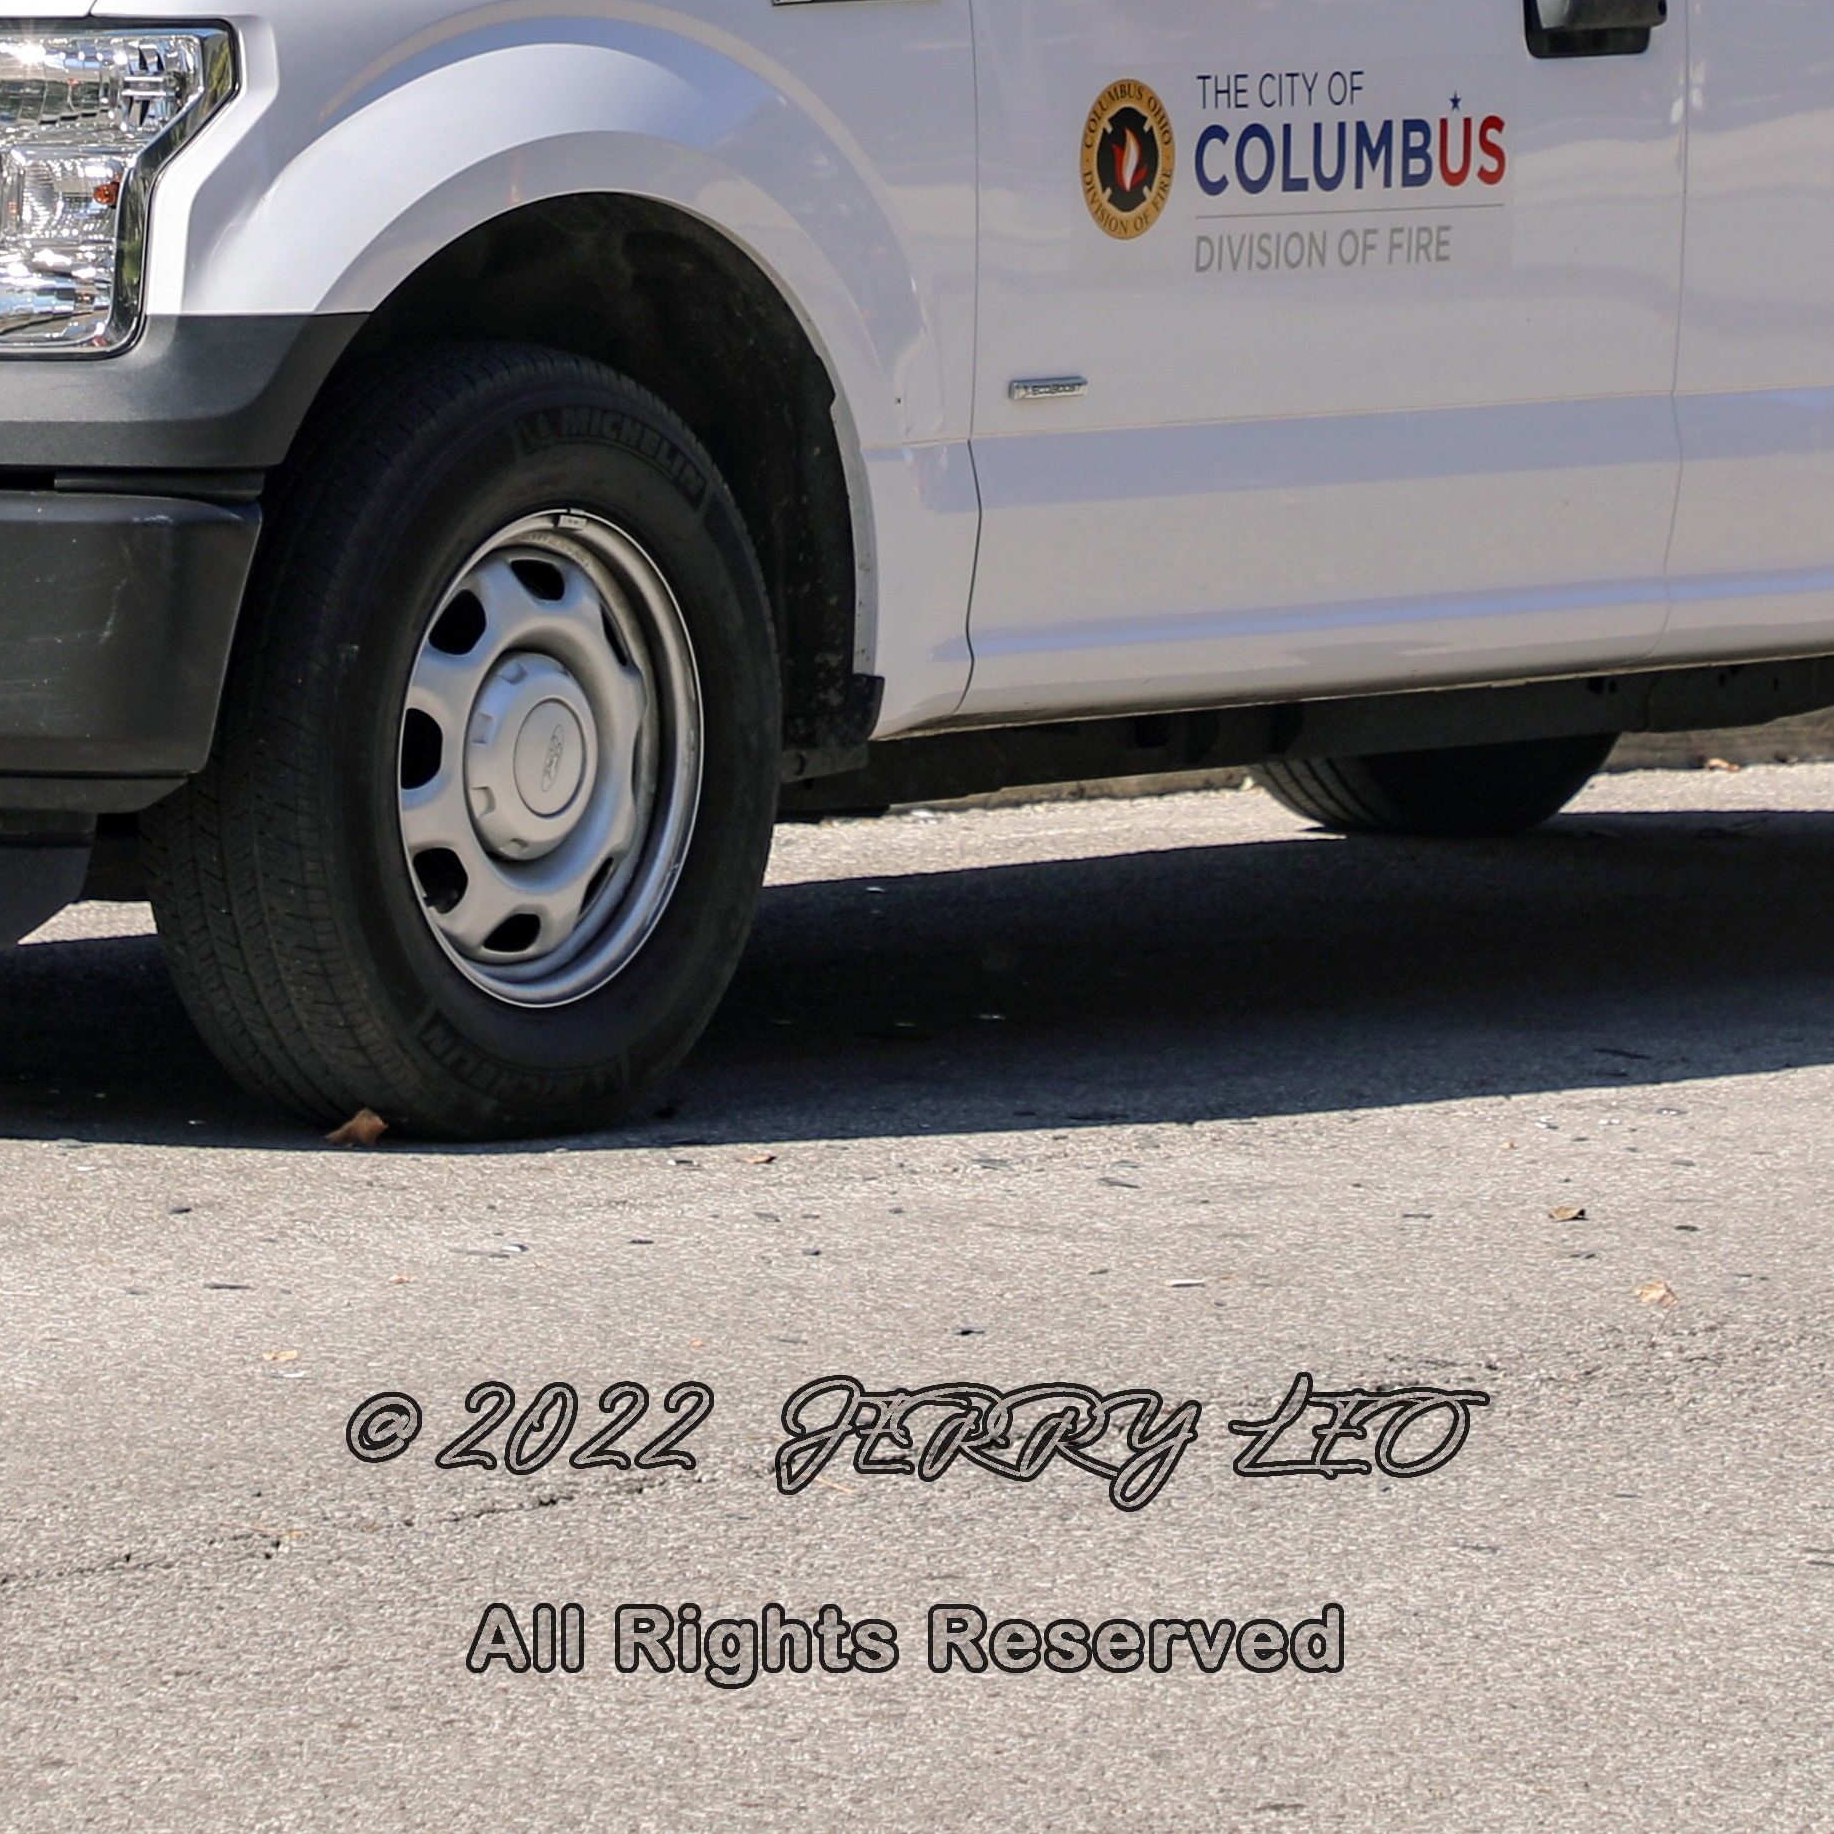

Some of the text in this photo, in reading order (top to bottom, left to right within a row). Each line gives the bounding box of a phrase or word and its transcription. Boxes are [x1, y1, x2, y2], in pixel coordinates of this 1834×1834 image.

[1084, 82, 1172, 149] COLUMBUS OHIO
[1195, 70, 1365, 110] THE CITY OF
[1194, 115, 1506, 197] COLUMBUS
[1082, 167, 1173, 234] DIVISION OF FIRE
[1194, 224, 1453, 273] DIVISION OF FIRE
